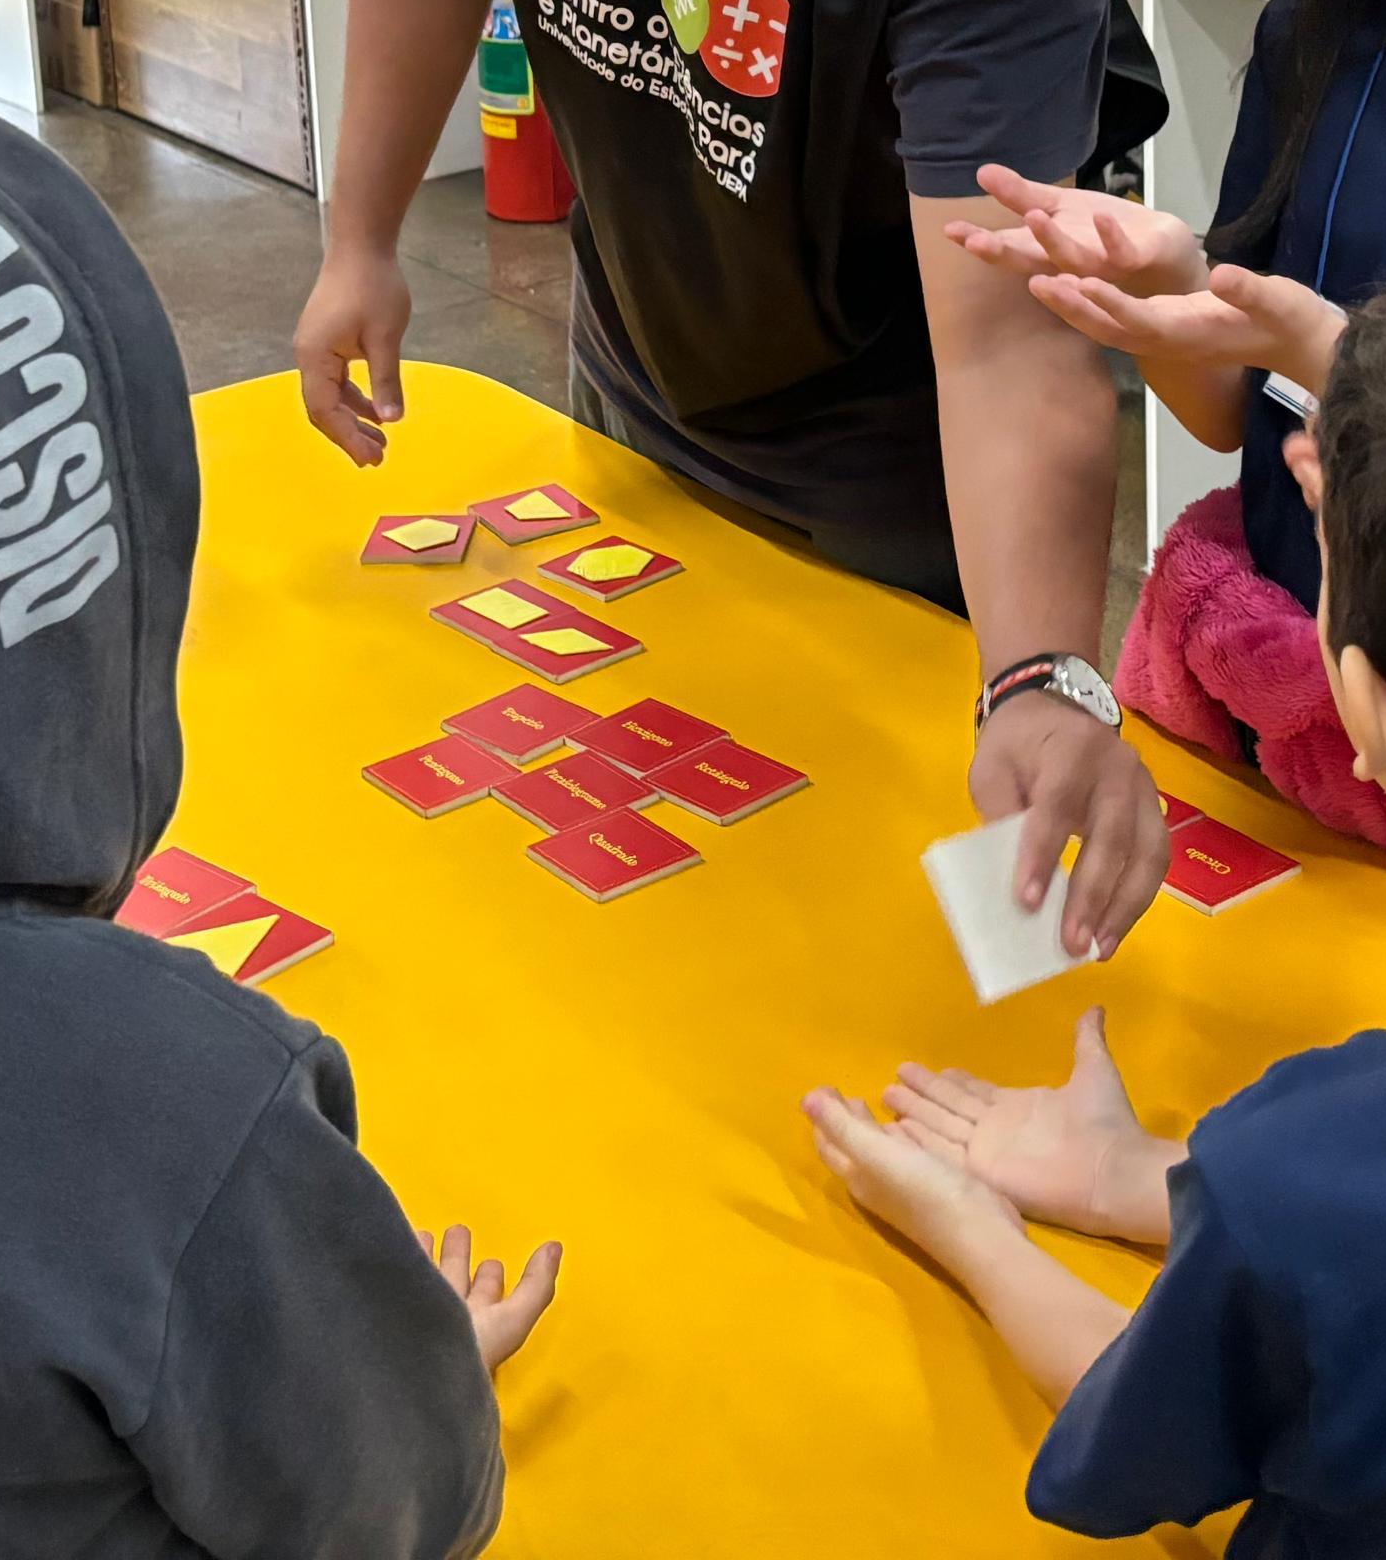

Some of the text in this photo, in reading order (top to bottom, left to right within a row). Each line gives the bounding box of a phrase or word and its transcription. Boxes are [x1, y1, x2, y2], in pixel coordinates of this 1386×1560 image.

[538, 15, 746, 202] Universidade do UEPA
[699, 122, 756, 183] Pará
